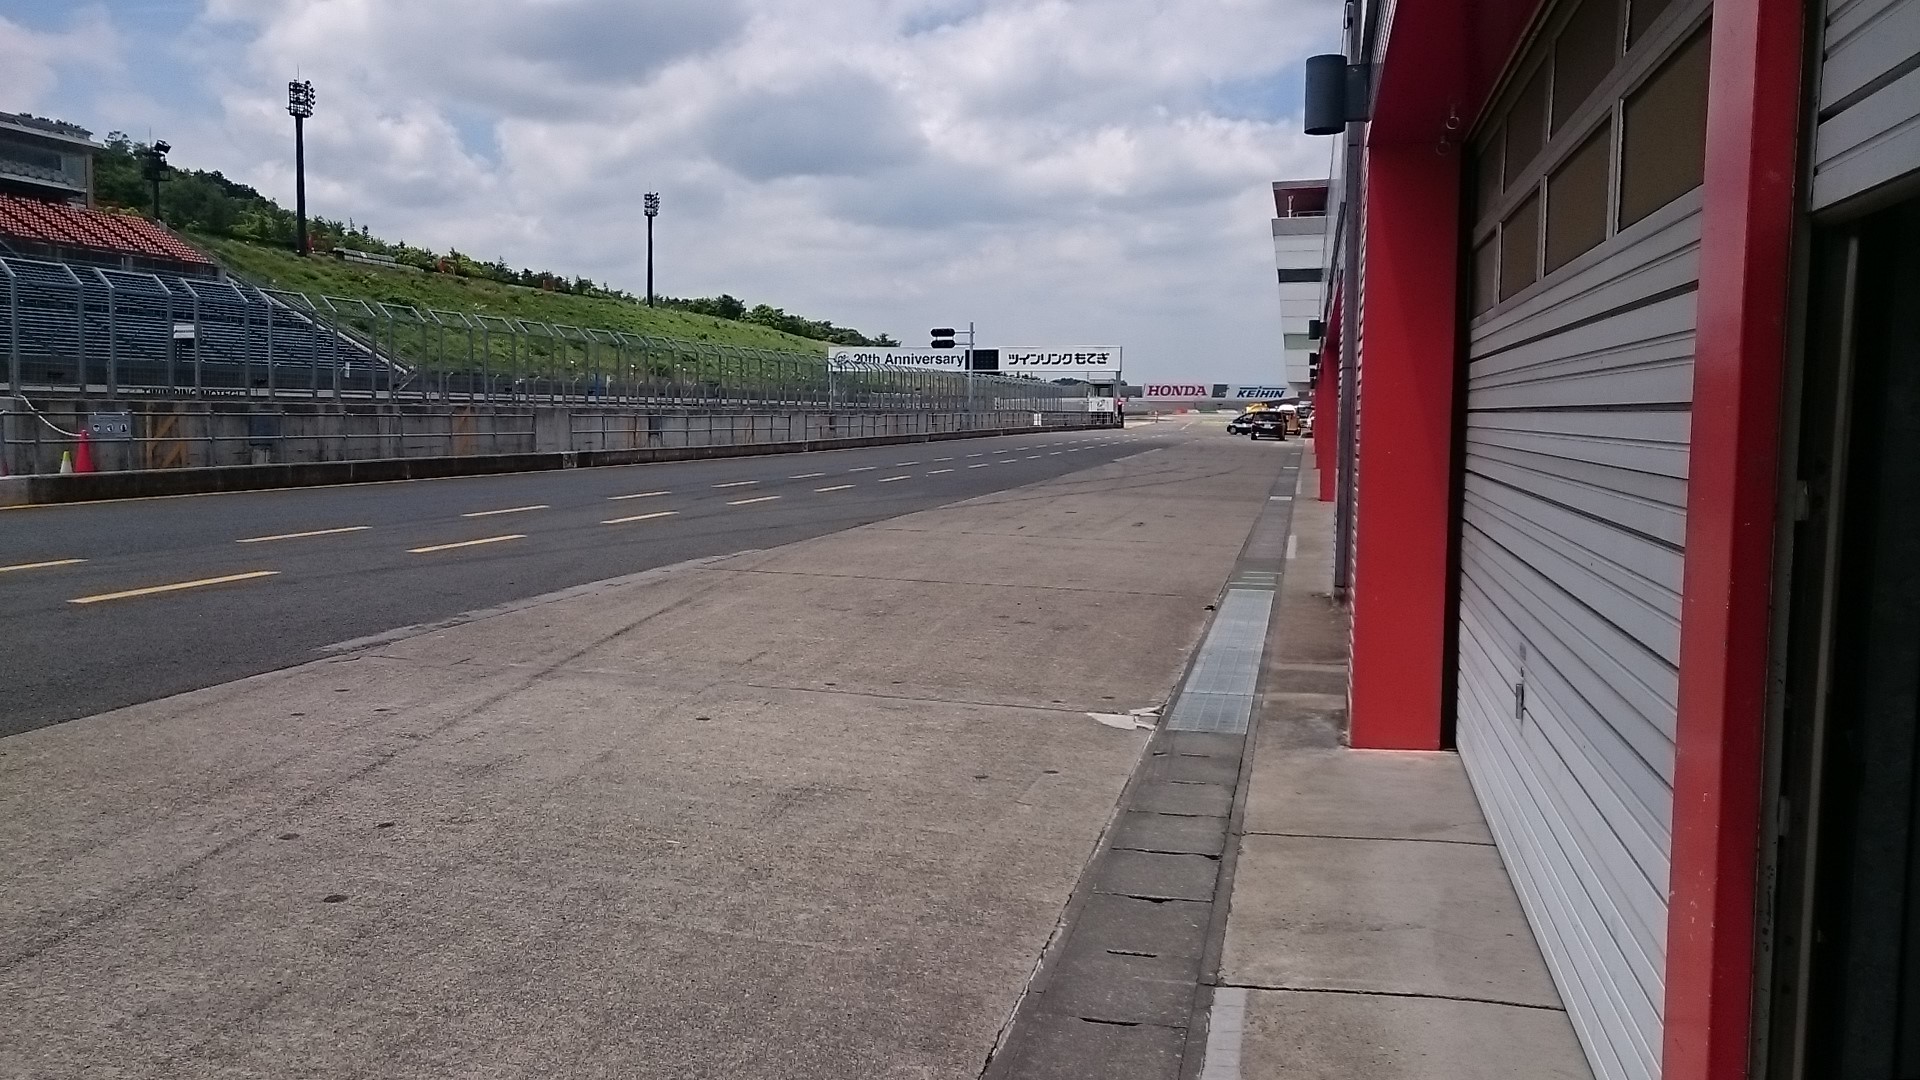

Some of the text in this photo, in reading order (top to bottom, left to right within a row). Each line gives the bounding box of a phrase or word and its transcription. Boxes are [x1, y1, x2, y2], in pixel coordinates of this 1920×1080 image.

[853, 352, 964, 367] 20th Anniversary
[1146, 384, 1208, 397] HONDA
